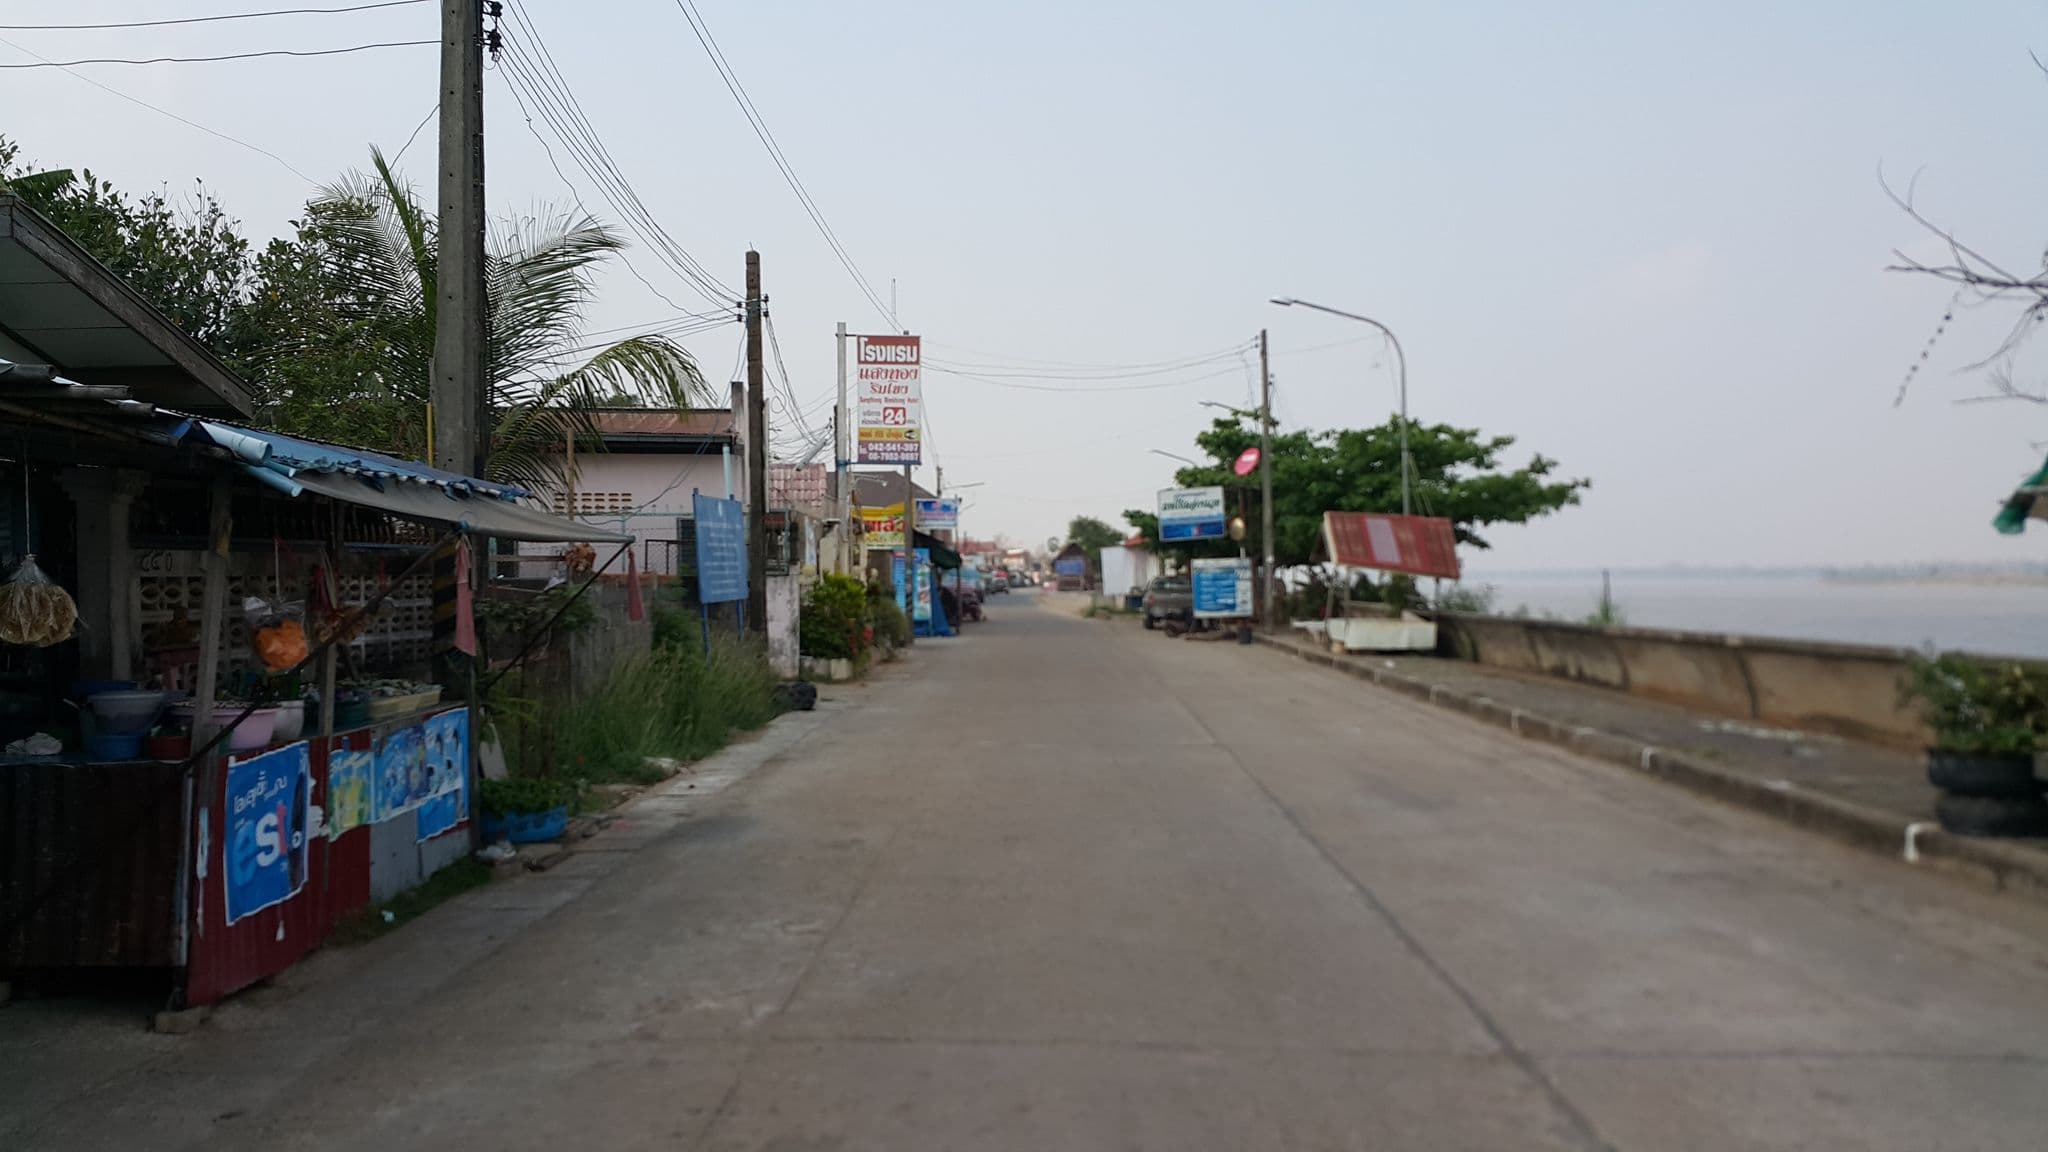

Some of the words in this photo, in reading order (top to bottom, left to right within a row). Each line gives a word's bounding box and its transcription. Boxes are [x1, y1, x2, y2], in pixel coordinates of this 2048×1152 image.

[859, 337, 918, 362] โรงแรม
[859, 367, 918, 381] แสงทอง
[884, 408, 905, 425] 24
